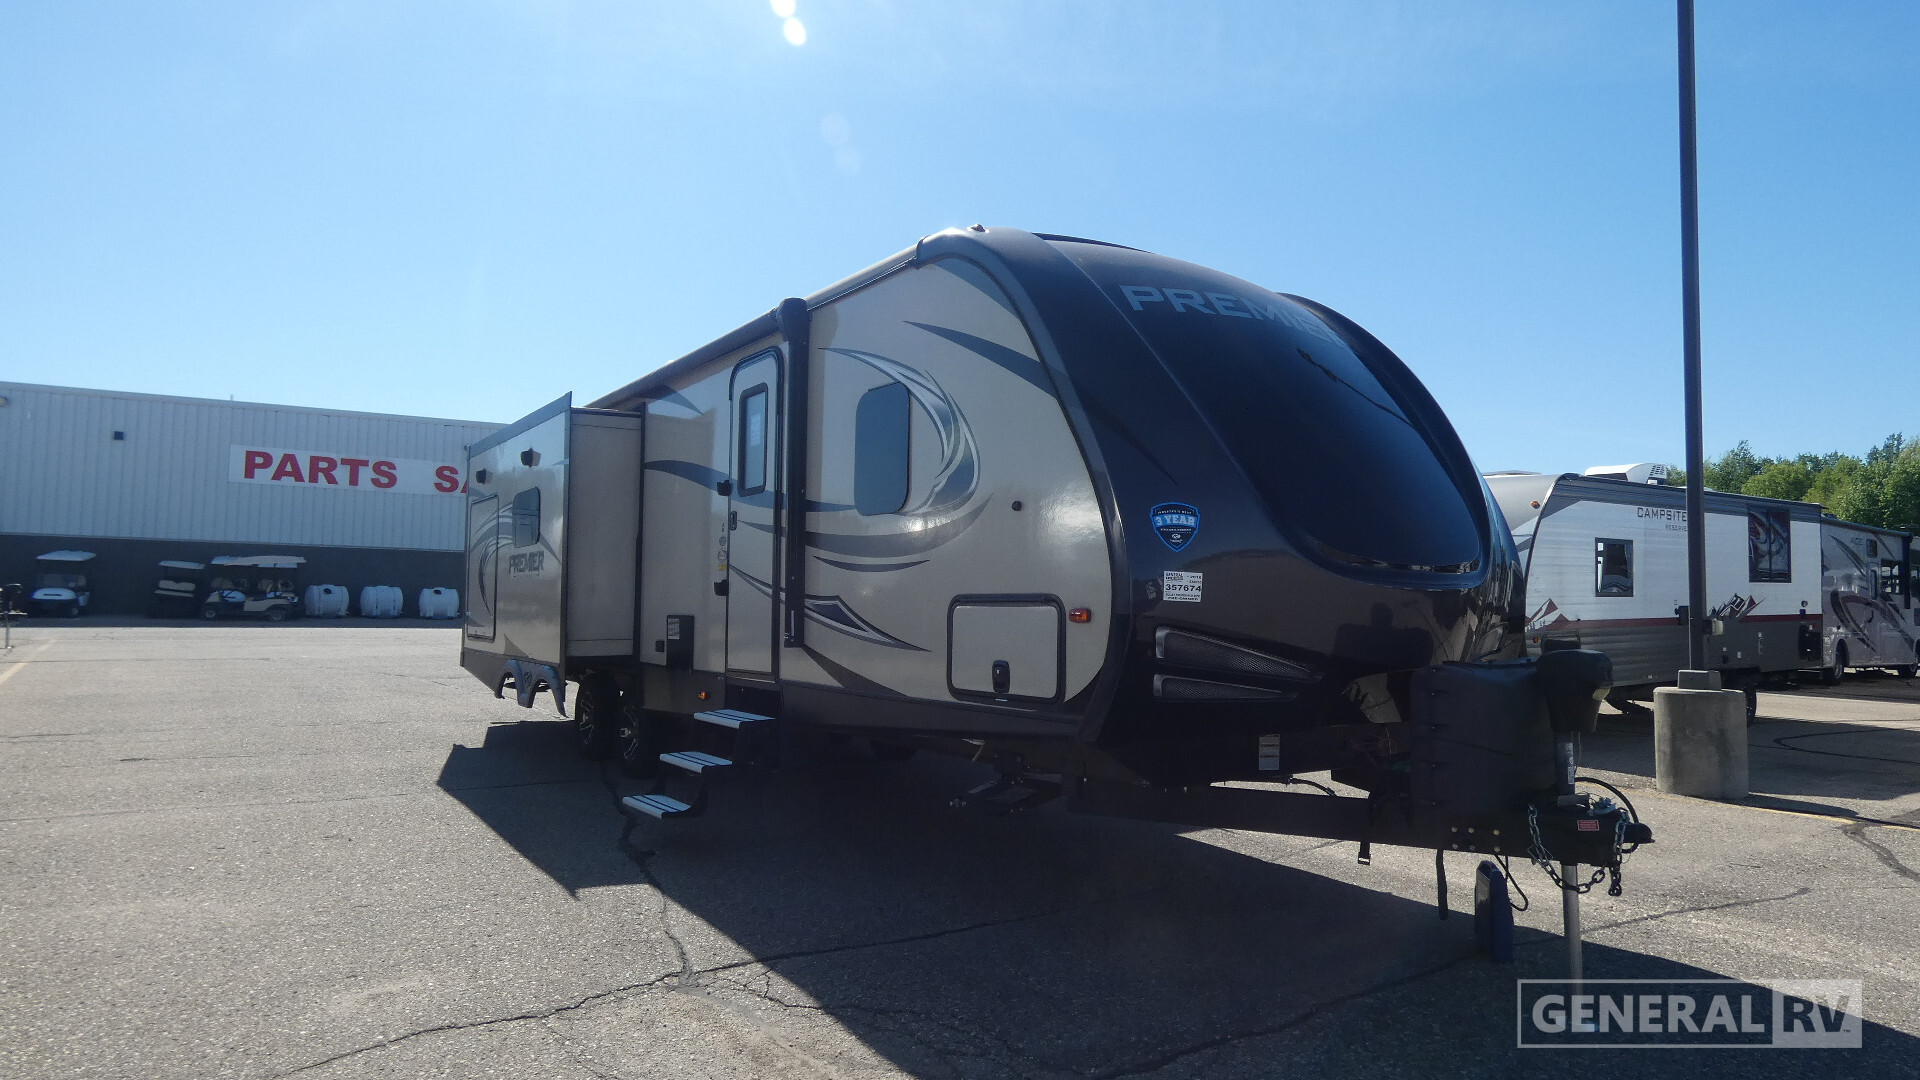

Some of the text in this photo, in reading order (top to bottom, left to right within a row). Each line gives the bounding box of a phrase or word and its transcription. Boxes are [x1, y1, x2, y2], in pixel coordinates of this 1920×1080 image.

[244, 450, 469, 494] PARTS S
[1155, 514, 1196, 526] 3 YEAR
[1637, 507, 1687, 522] CAMPSITE
[508, 550, 545, 574] PREMIER
[1165, 583, 1202, 592] 357674
